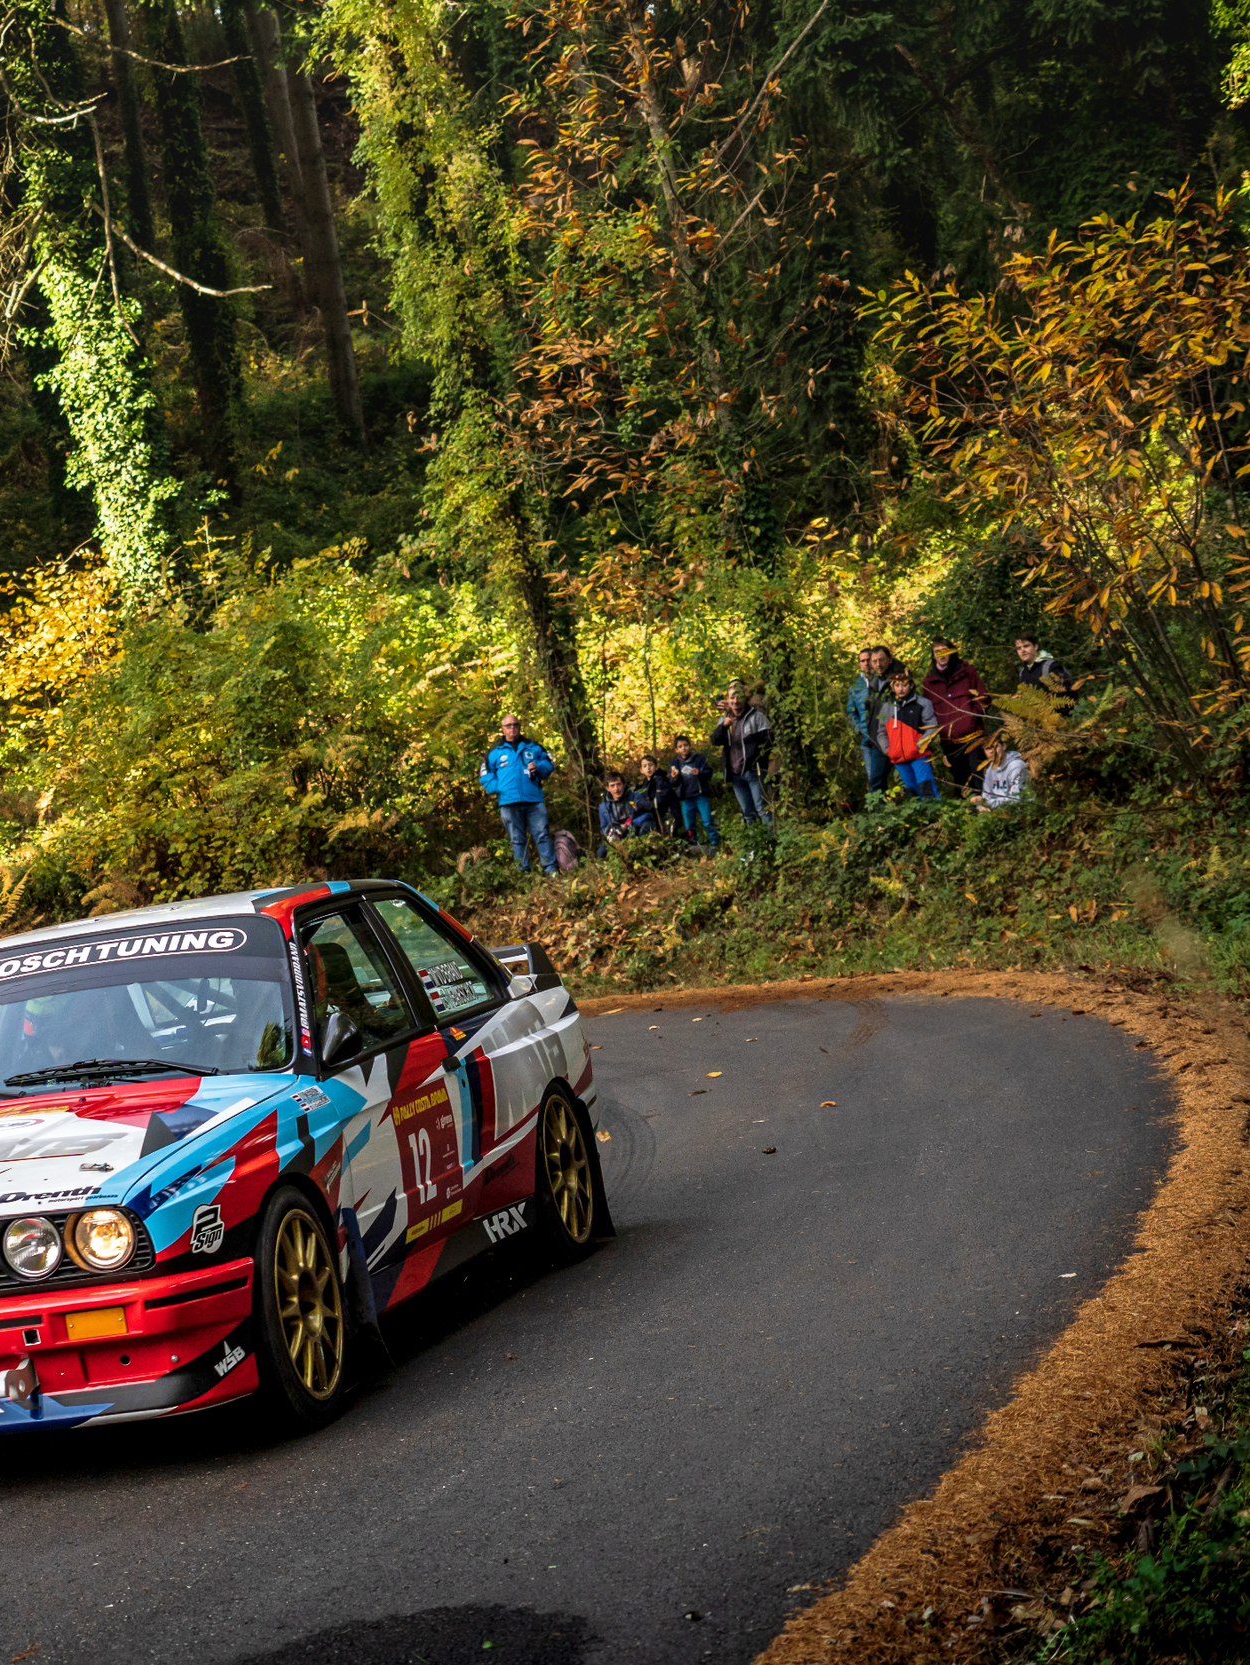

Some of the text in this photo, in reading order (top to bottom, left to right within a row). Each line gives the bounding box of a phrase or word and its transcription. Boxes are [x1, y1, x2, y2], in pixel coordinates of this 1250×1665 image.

[96, 931, 235, 957] TUNING
[408, 1128, 438, 1205] 12
[48, 1195, 84, 1203] motorsport
[482, 1201, 528, 1243] HRX
[194, 1229, 222, 1251] Sign
[213, 1345, 246, 1377] WSB
